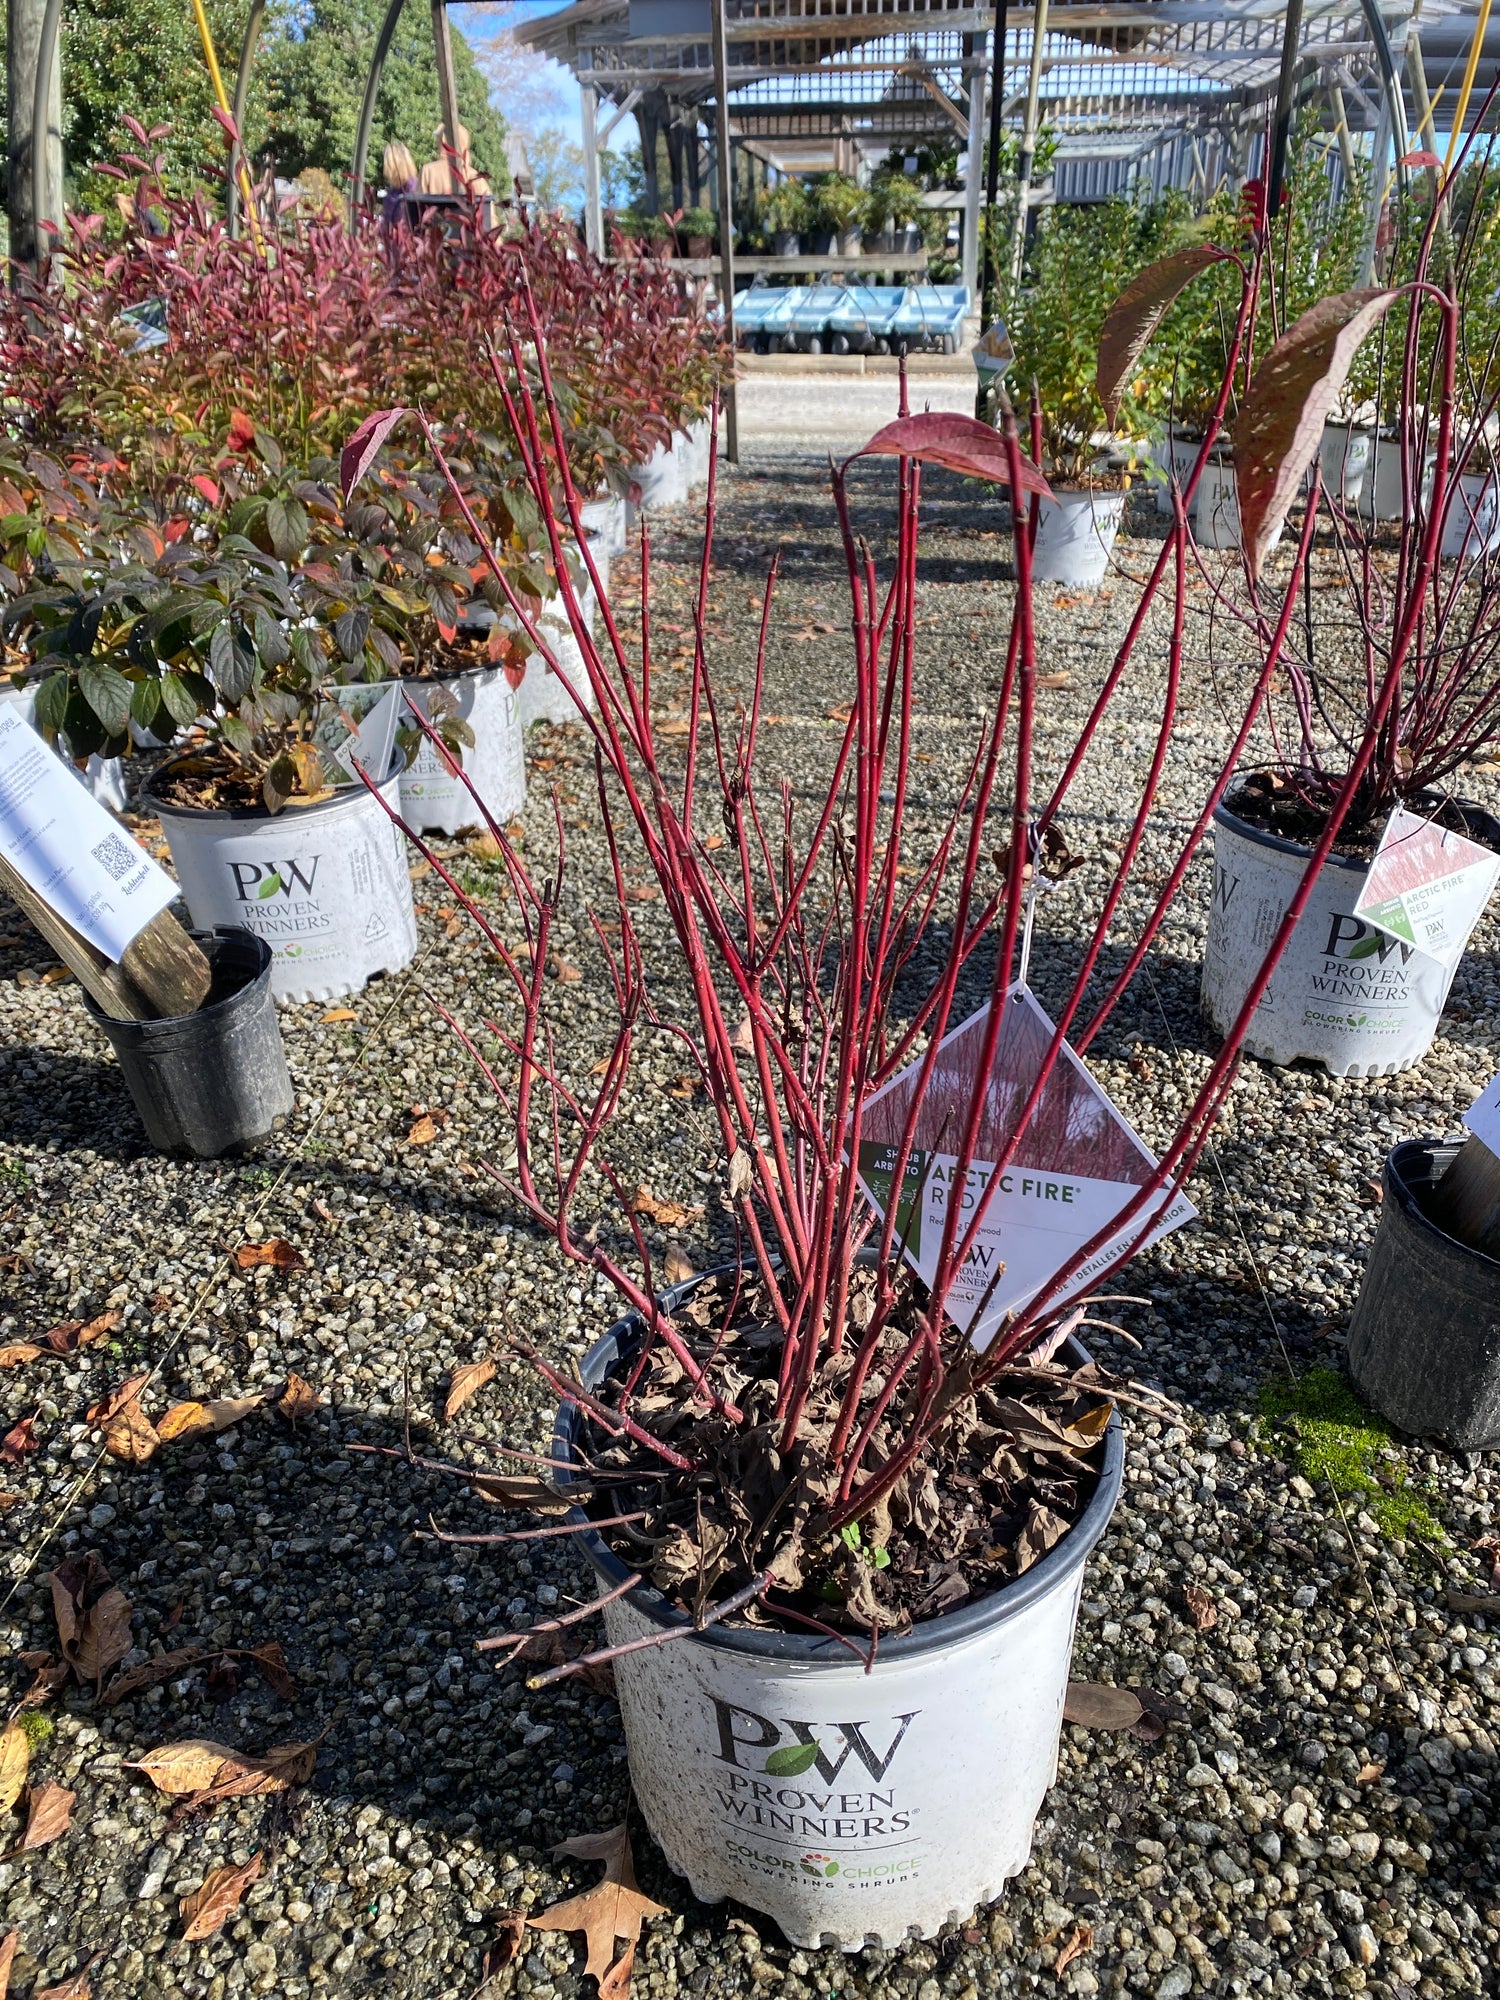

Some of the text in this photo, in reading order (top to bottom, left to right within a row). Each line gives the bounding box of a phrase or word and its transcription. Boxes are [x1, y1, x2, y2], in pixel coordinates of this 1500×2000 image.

[1406, 884, 1440, 905] ARCTIC
[244, 900, 321, 918] PROVEN
[1409, 901, 1429, 915] RED
[1322, 961, 1409, 984] PROVEN
[1304, 1010, 1344, 1024] COLOR
[886, 1148, 920, 1163] SHUB
[873, 1160, 918, 1176] ARBTO
[932, 1164, 1014, 1193] ACTC
[932, 1186, 975, 1209] RD
[964, 1222, 1001, 1236] Dgwood
[1076, 1249, 1117, 1280] DETALLES
[1118, 1240, 1131, 1253] EN
[955, 1274, 991, 1289] INNERS
[957, 1266, 990, 1279] ROVEN
[703, 1692, 923, 1787] PW
[727, 1770, 896, 1813] PROVEN
[725, 1840, 923, 1879] COLOR CHOICE
[728, 1854, 920, 1889] FLOWERING SHRUBS
